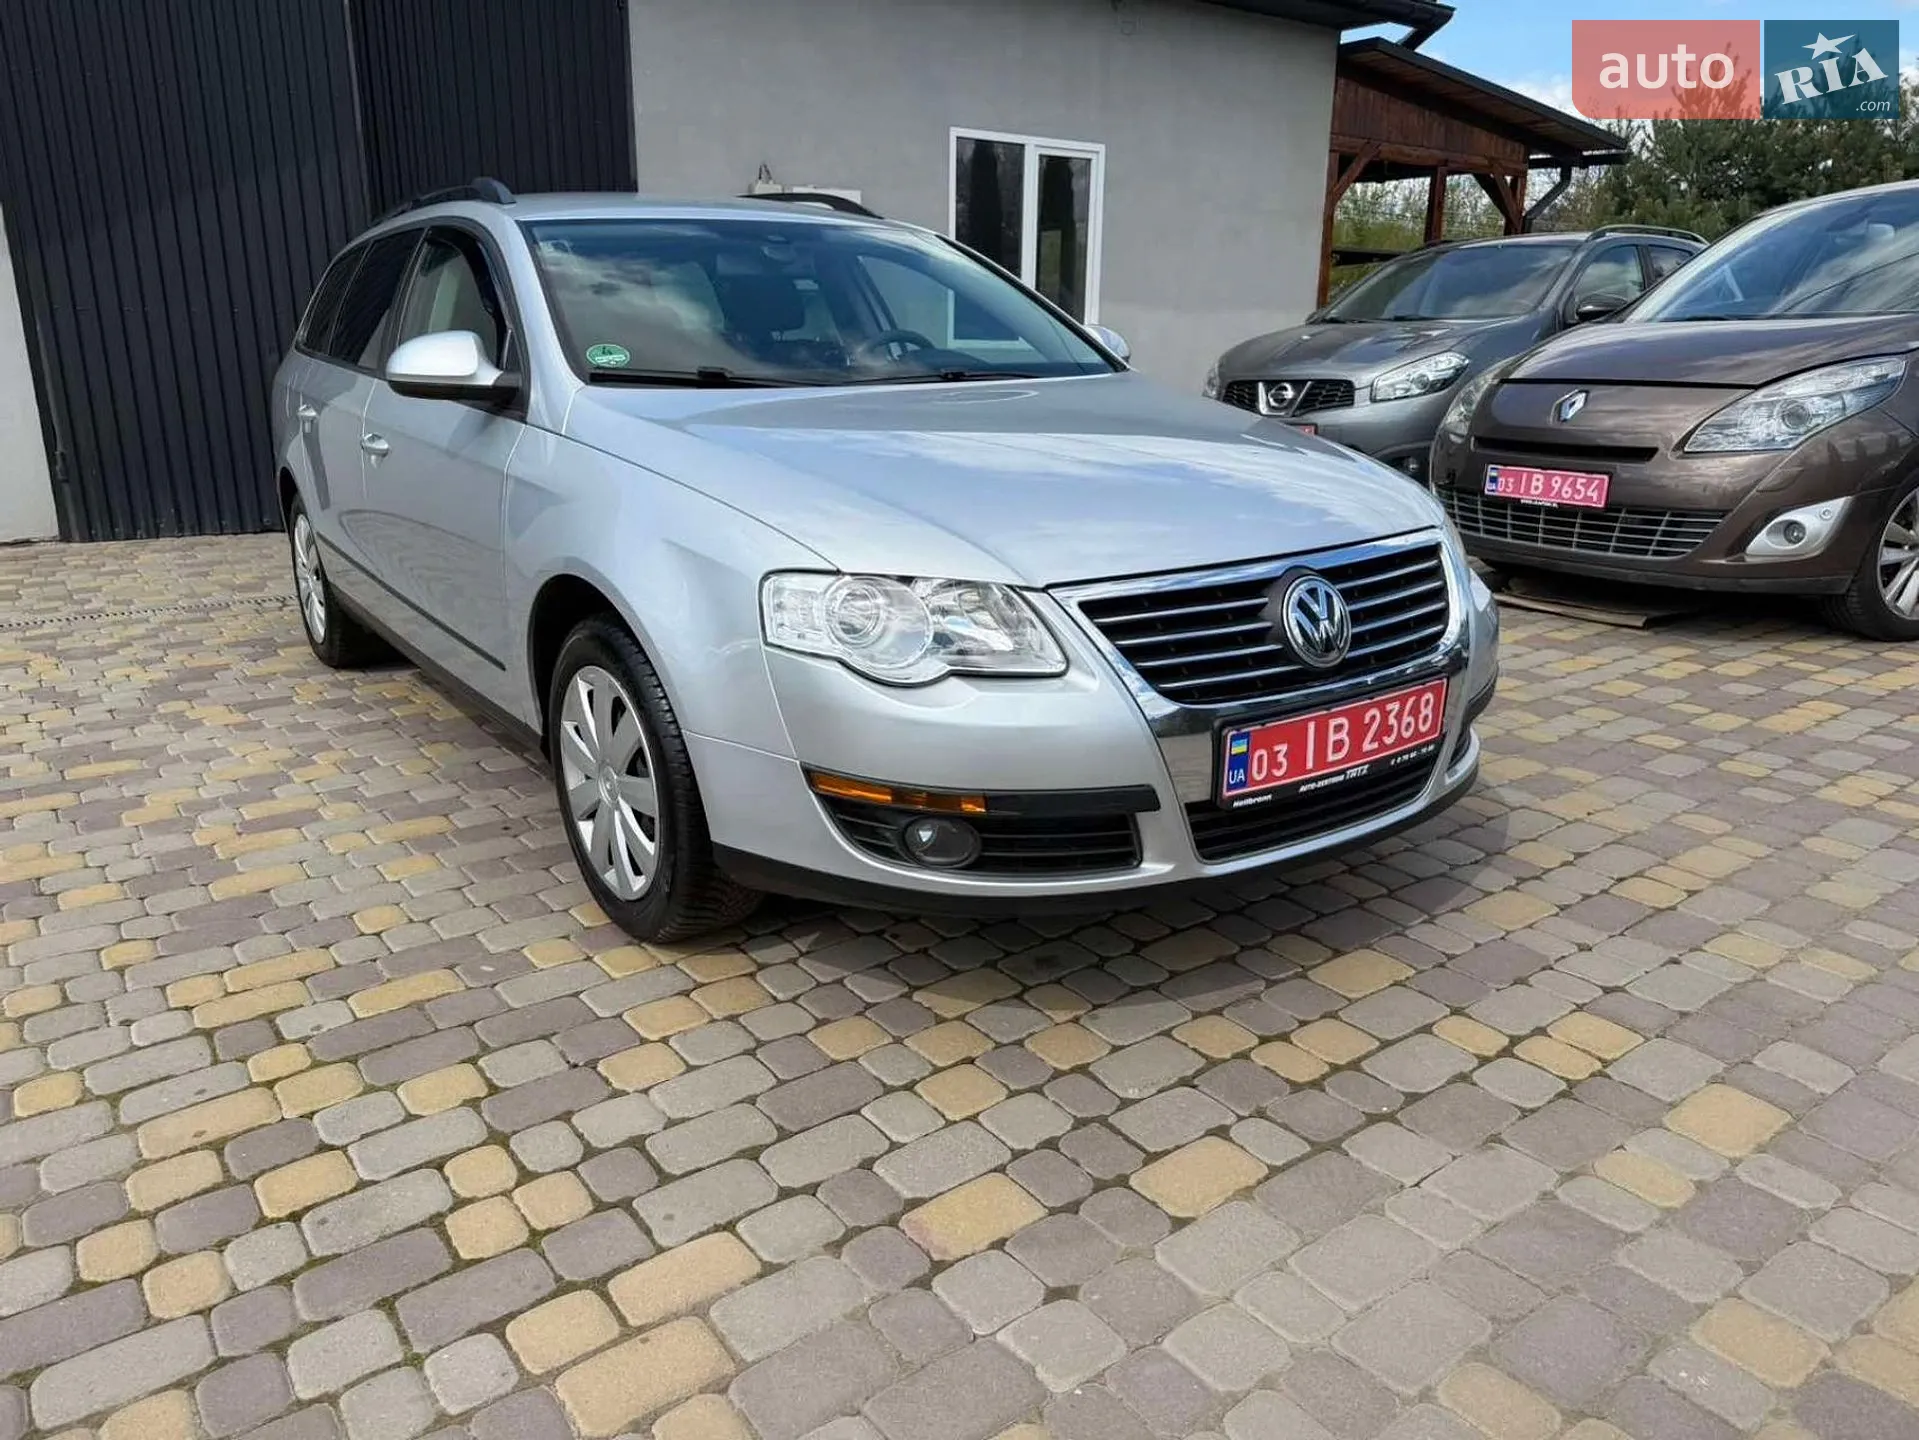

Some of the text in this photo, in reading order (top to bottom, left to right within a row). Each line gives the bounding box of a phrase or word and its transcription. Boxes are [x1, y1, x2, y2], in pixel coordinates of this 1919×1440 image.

[1497, 477, 1515, 492] 03
[1549, 475, 1600, 502] 9654
[1251, 743, 1288, 781] 03
[1362, 692, 1435, 752] 2368
[1229, 768, 1245, 784] UA
